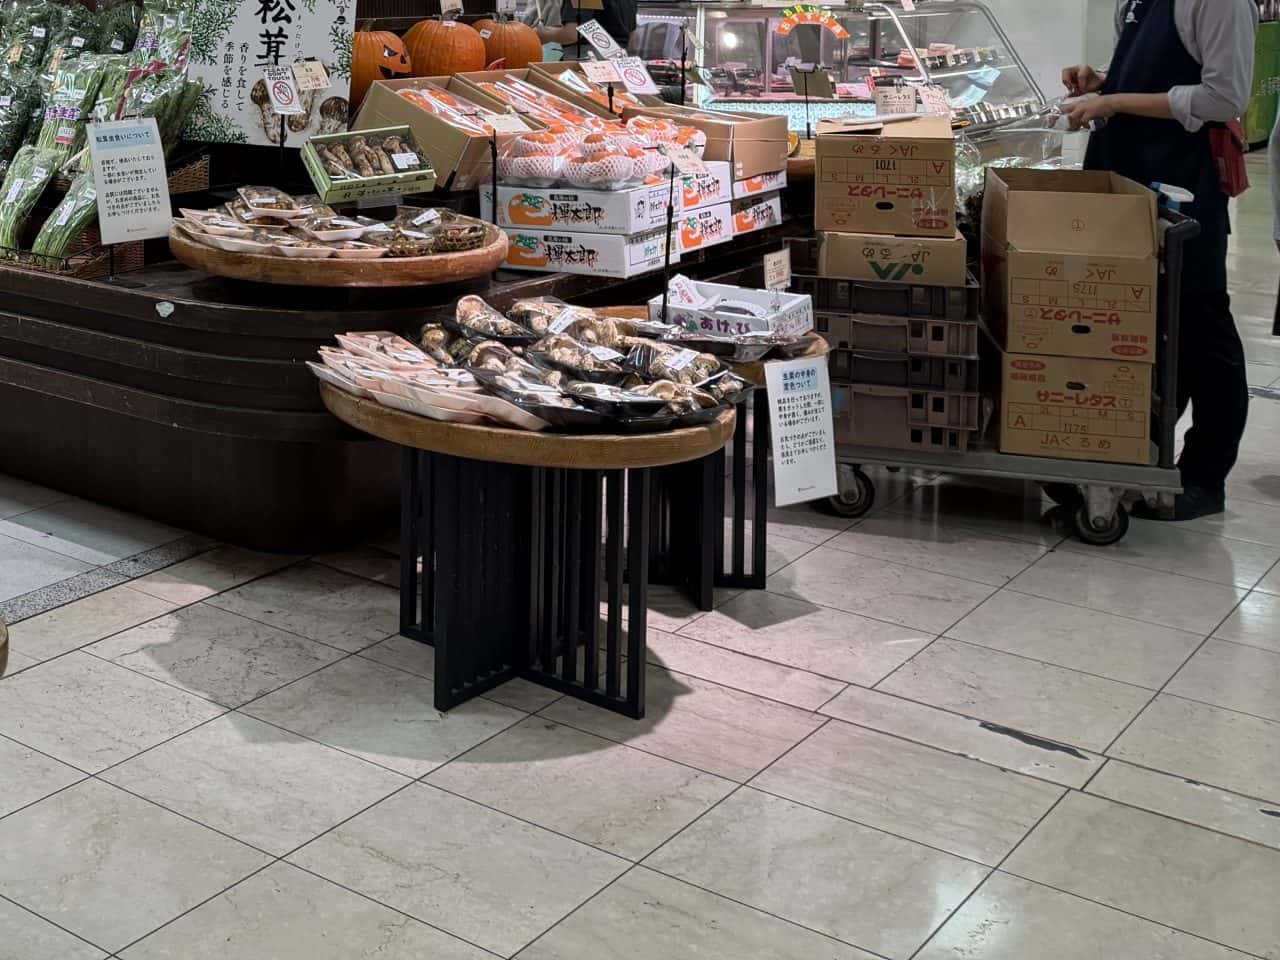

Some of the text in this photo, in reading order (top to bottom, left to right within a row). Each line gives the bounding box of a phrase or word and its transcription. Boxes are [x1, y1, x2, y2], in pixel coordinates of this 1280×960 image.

[221, 41, 234, 109] 季節を感じる
[235, 42, 250, 111] 香りを食して
[852, 144, 918, 156] JAくるめ
[875, 160, 896, 170] 1701
[932, 162, 944, 174] A
[848, 185, 924, 198] サニーレタス
[550, 201, 604, 224] 輝太郎
[544, 244, 600, 267] 輝太郎
[862, 246, 931, 262] JAるめ
[1045, 265, 1120, 282] JAくめ
[1132, 287, 1144, 300] A
[1040, 308, 1122, 326] サニーレタス
[1036, 389, 1118, 408] サニーレタス
[1014, 414, 1026, 427] A
[1040, 433, 1112, 450] JAくるめ
